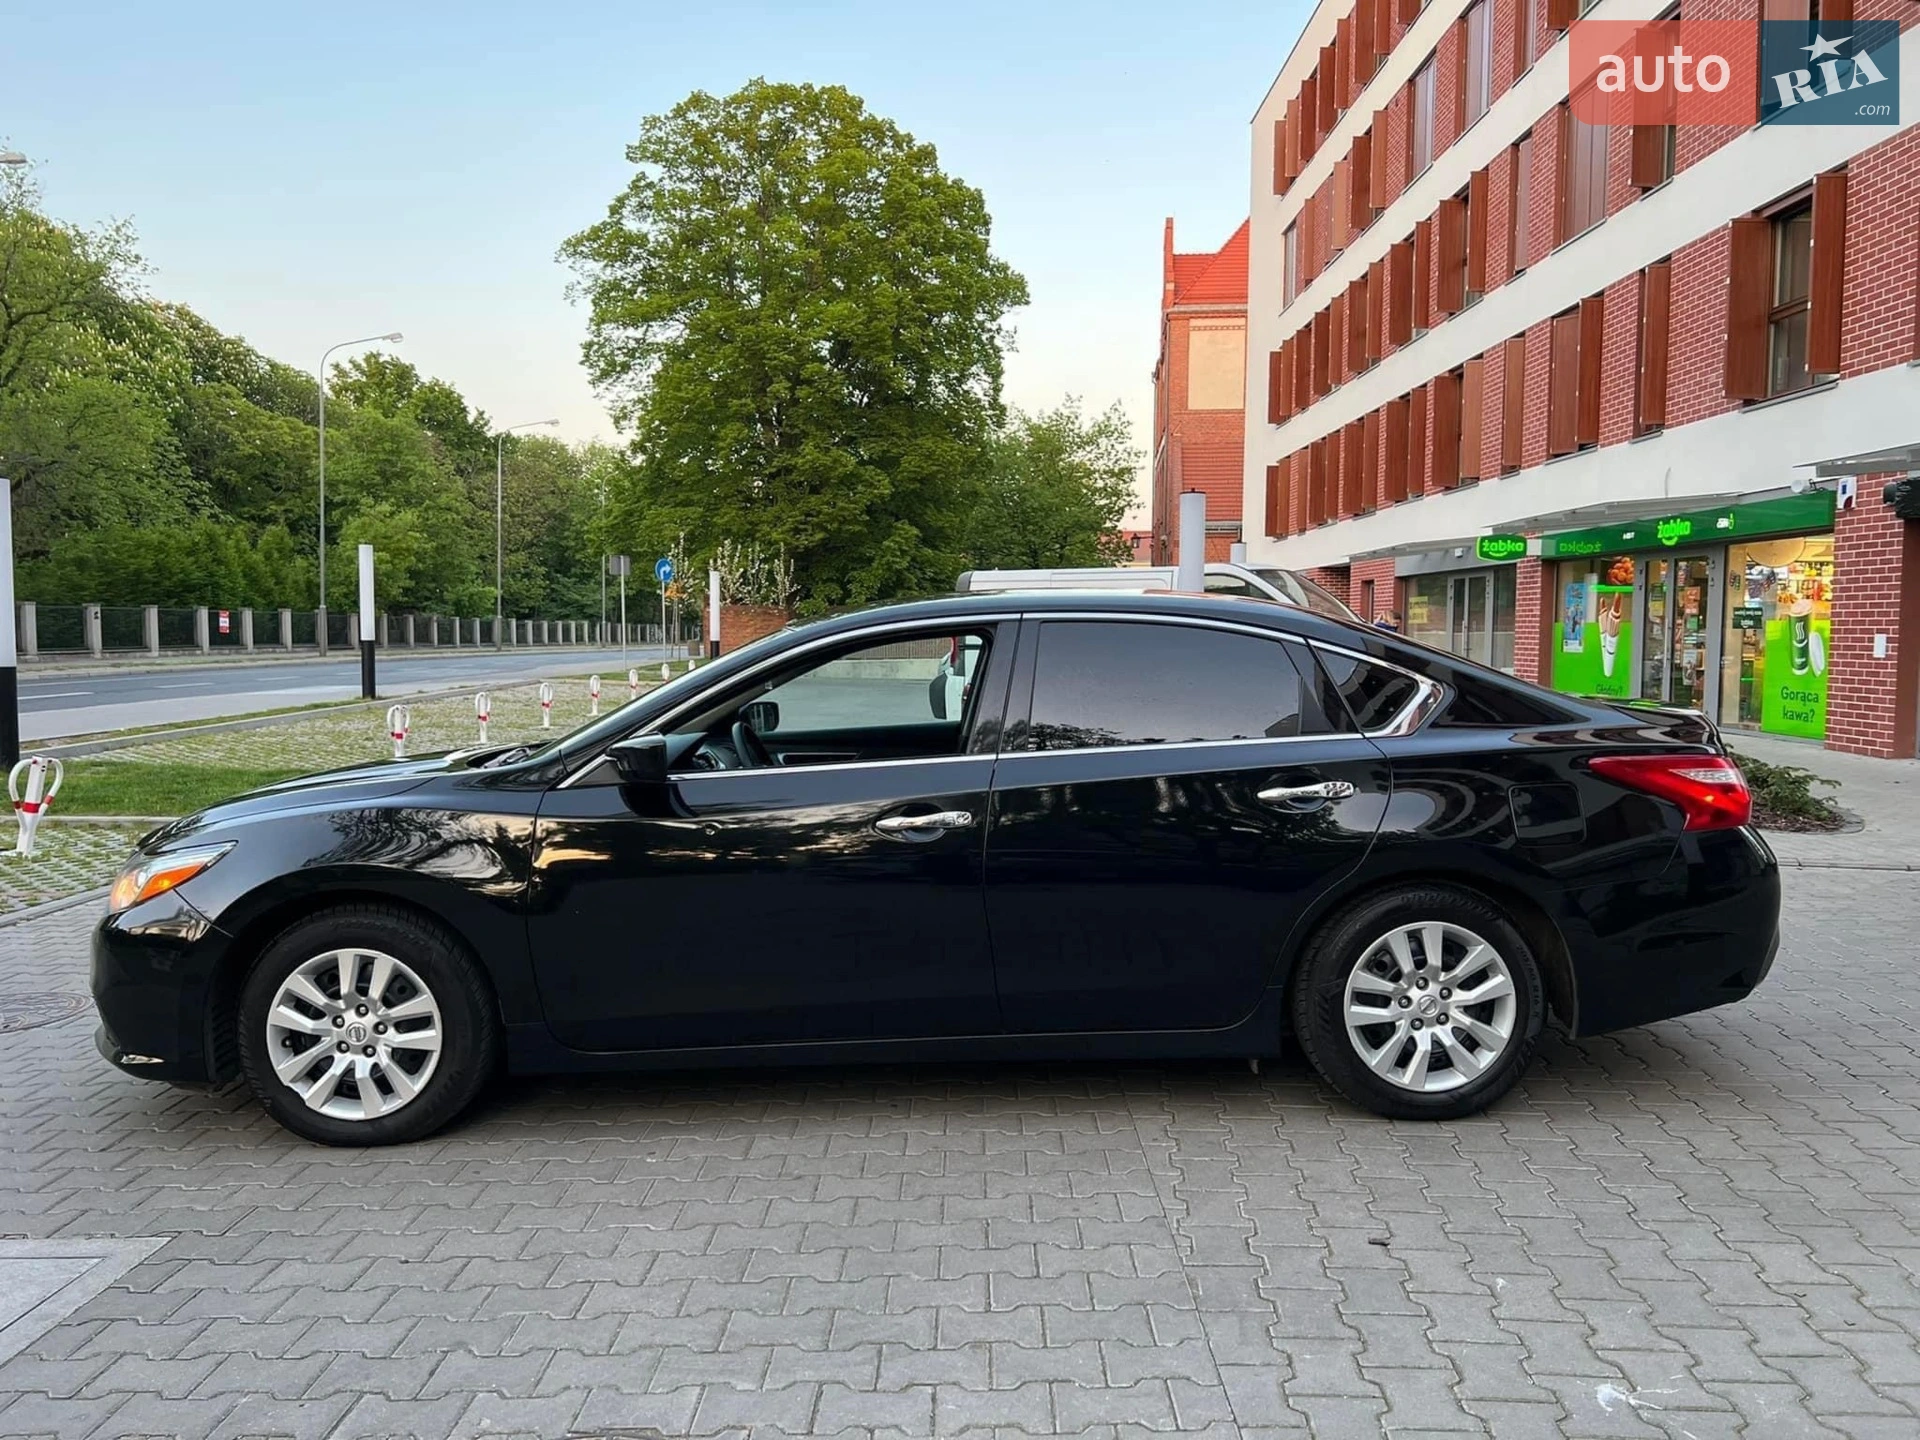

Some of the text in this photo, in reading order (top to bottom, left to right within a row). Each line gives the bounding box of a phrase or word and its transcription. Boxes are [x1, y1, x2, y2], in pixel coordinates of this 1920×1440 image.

[1657, 518, 1691, 538] żabka
[1482, 539, 1525, 552] żabka
[1781, 686, 1819, 706] Gorąca
[1782, 705, 1815, 723] kawa?
